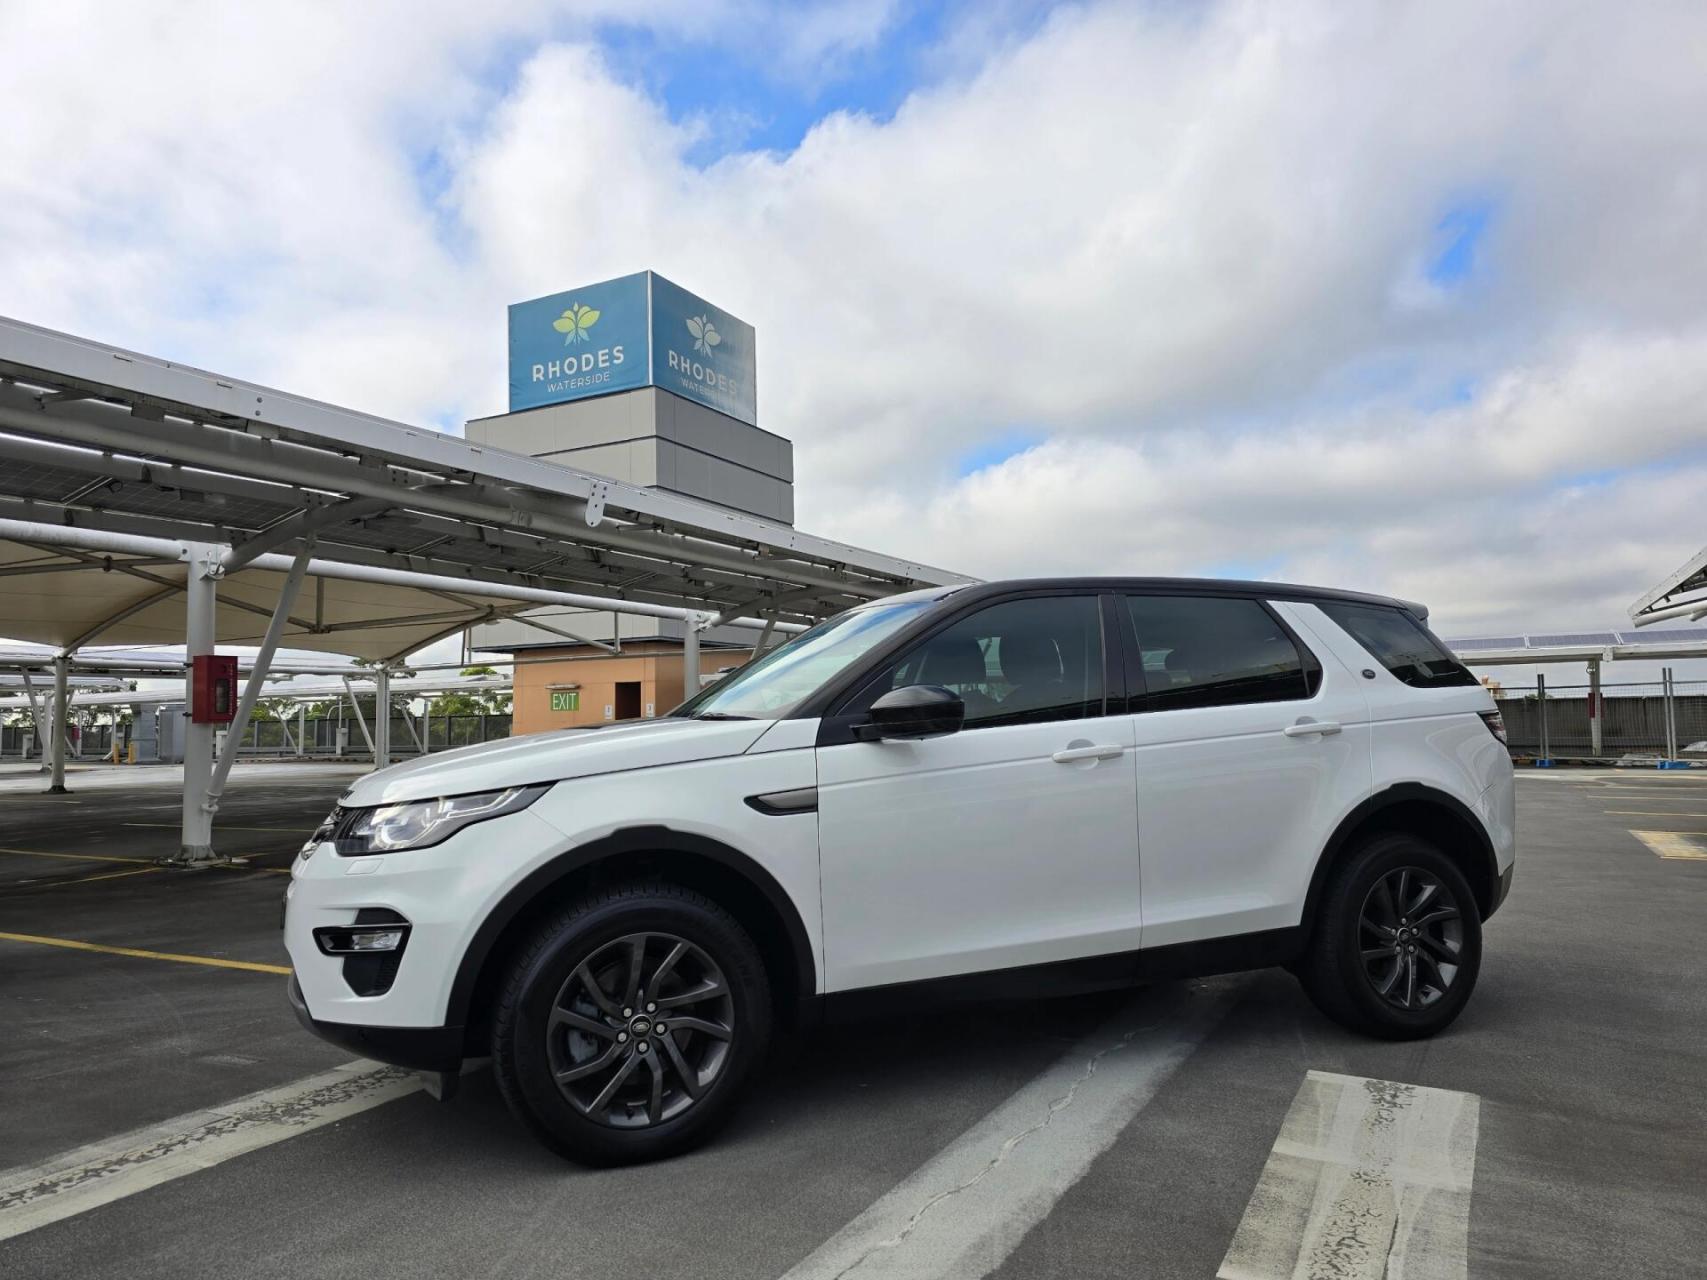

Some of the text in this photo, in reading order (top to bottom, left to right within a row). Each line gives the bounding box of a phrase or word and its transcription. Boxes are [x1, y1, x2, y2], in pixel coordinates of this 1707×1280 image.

[532, 345, 624, 382] RHODES
[668, 350, 737, 394] RHODES
[547, 371, 610, 393] WATERSIDE
[553, 693, 577, 710] EXIT
